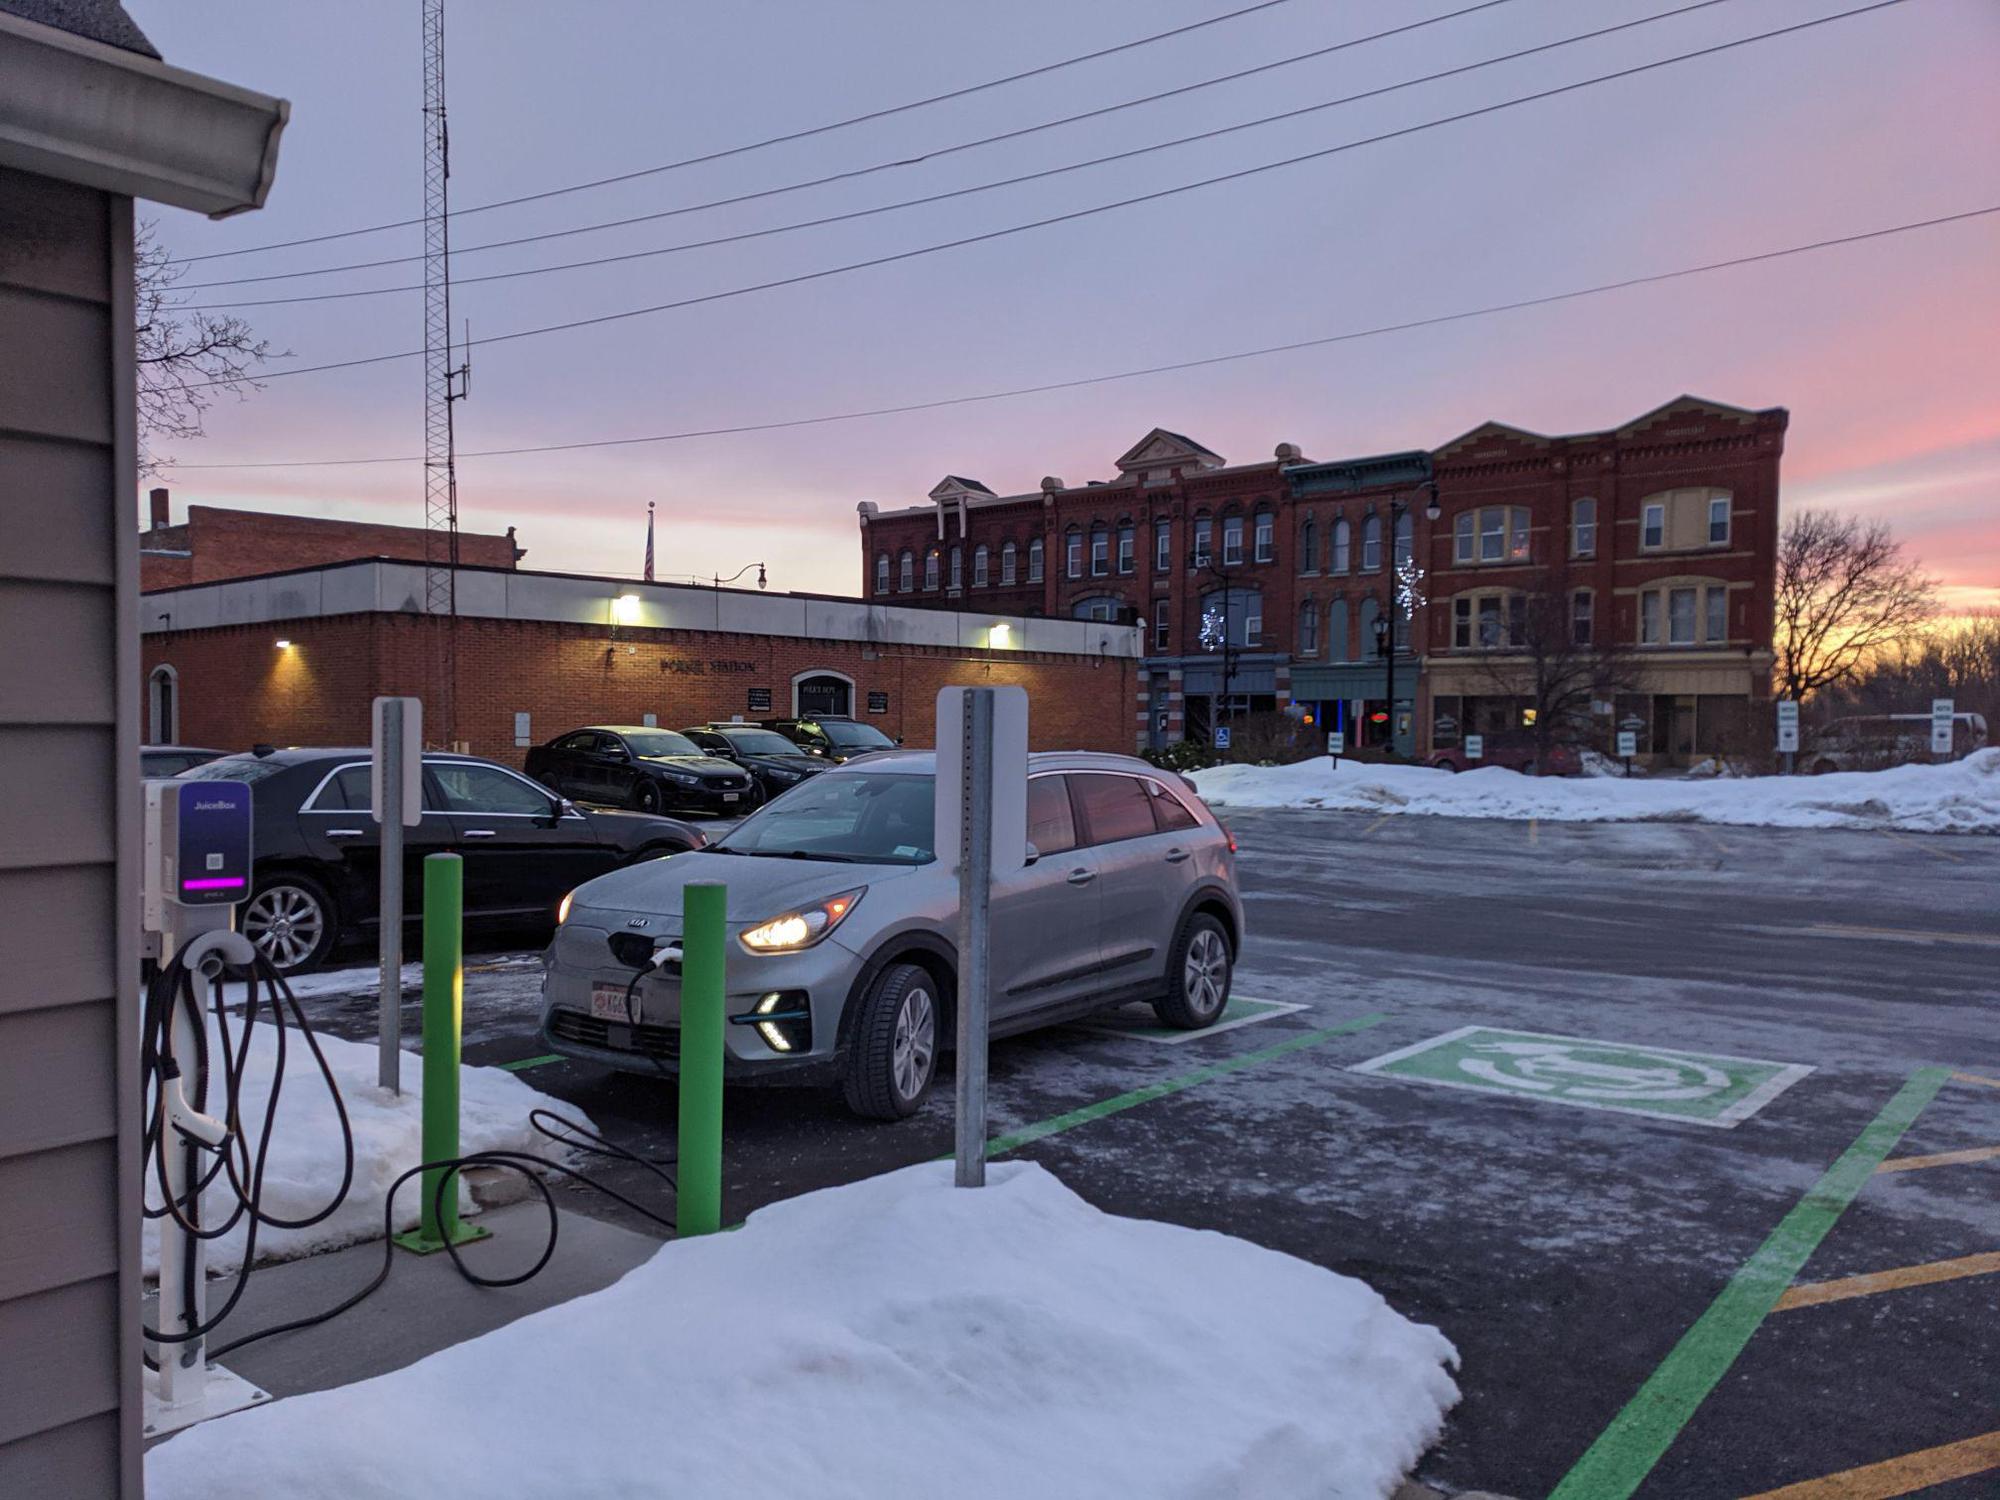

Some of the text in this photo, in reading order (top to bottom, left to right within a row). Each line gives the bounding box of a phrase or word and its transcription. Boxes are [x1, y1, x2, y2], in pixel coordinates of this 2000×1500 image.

[709, 660, 755, 673] STATION
[194, 800, 237, 811] JuiceBox
[628, 918, 649, 928] KIA
